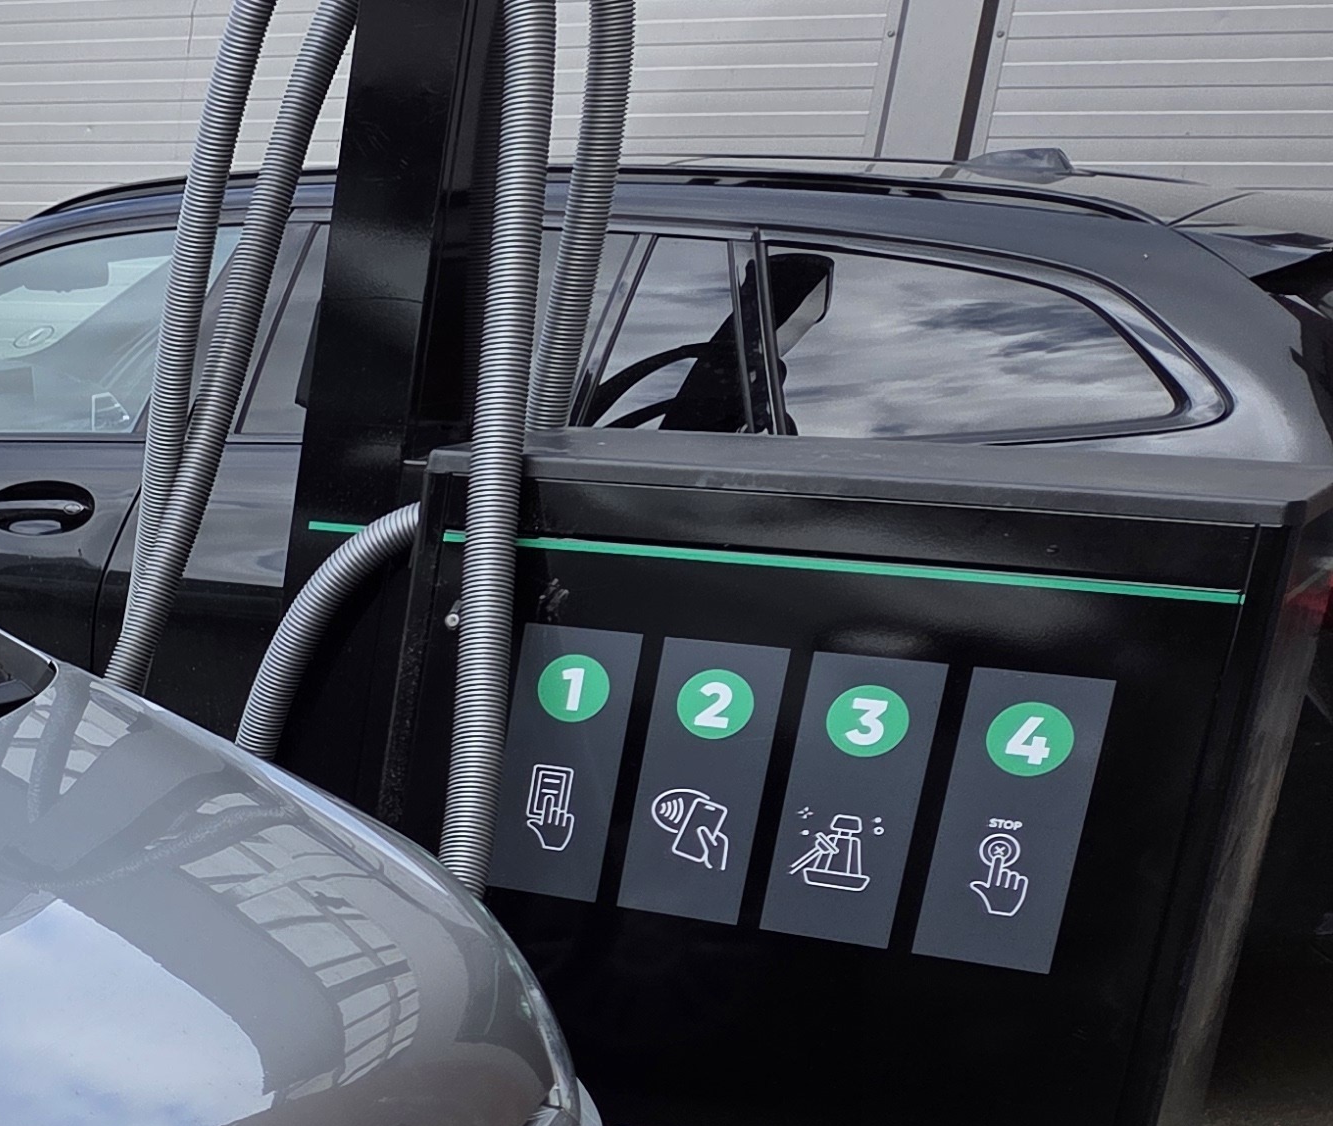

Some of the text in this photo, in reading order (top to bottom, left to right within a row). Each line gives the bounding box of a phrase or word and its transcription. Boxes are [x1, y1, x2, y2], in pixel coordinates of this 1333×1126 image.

[562, 668, 584, 711] 1
[694, 681, 732, 729] 2
[844, 698, 888, 745] 3
[1005, 716, 1049, 765] 4
[988, 818, 1023, 830] STOP
